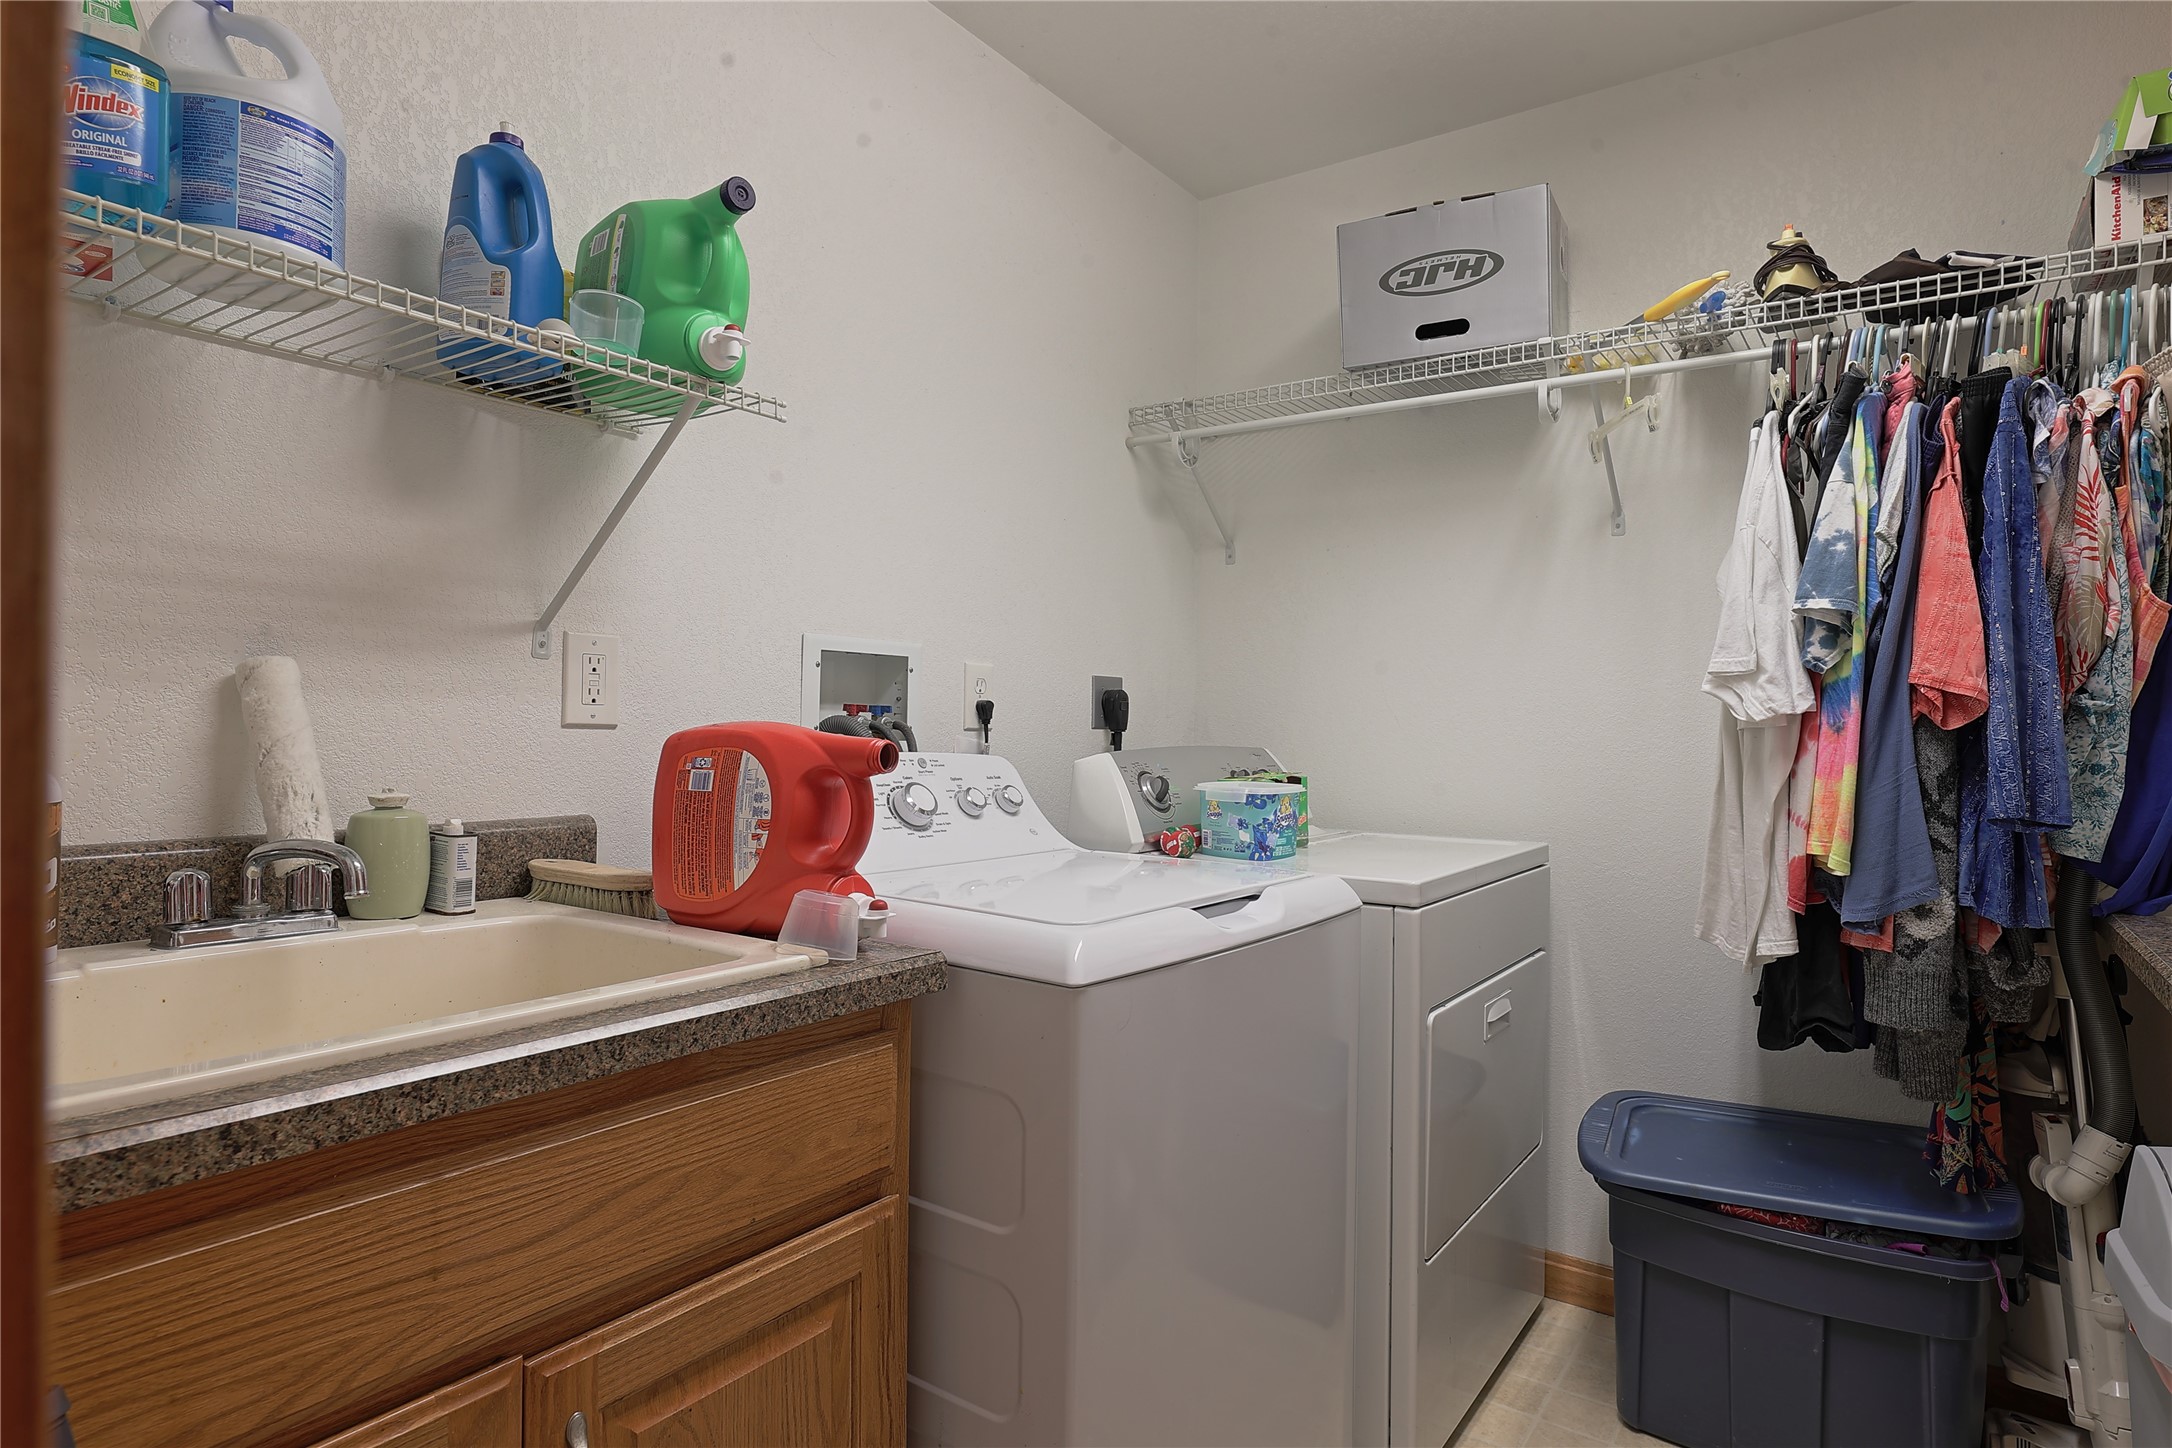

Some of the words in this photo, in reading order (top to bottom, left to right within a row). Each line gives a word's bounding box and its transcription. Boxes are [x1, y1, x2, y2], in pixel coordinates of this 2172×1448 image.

[71, 128, 128, 147] ORIGINAL
[2111, 175, 2121, 241] KitchenAid
[1395, 255, 1487, 291] HJC
